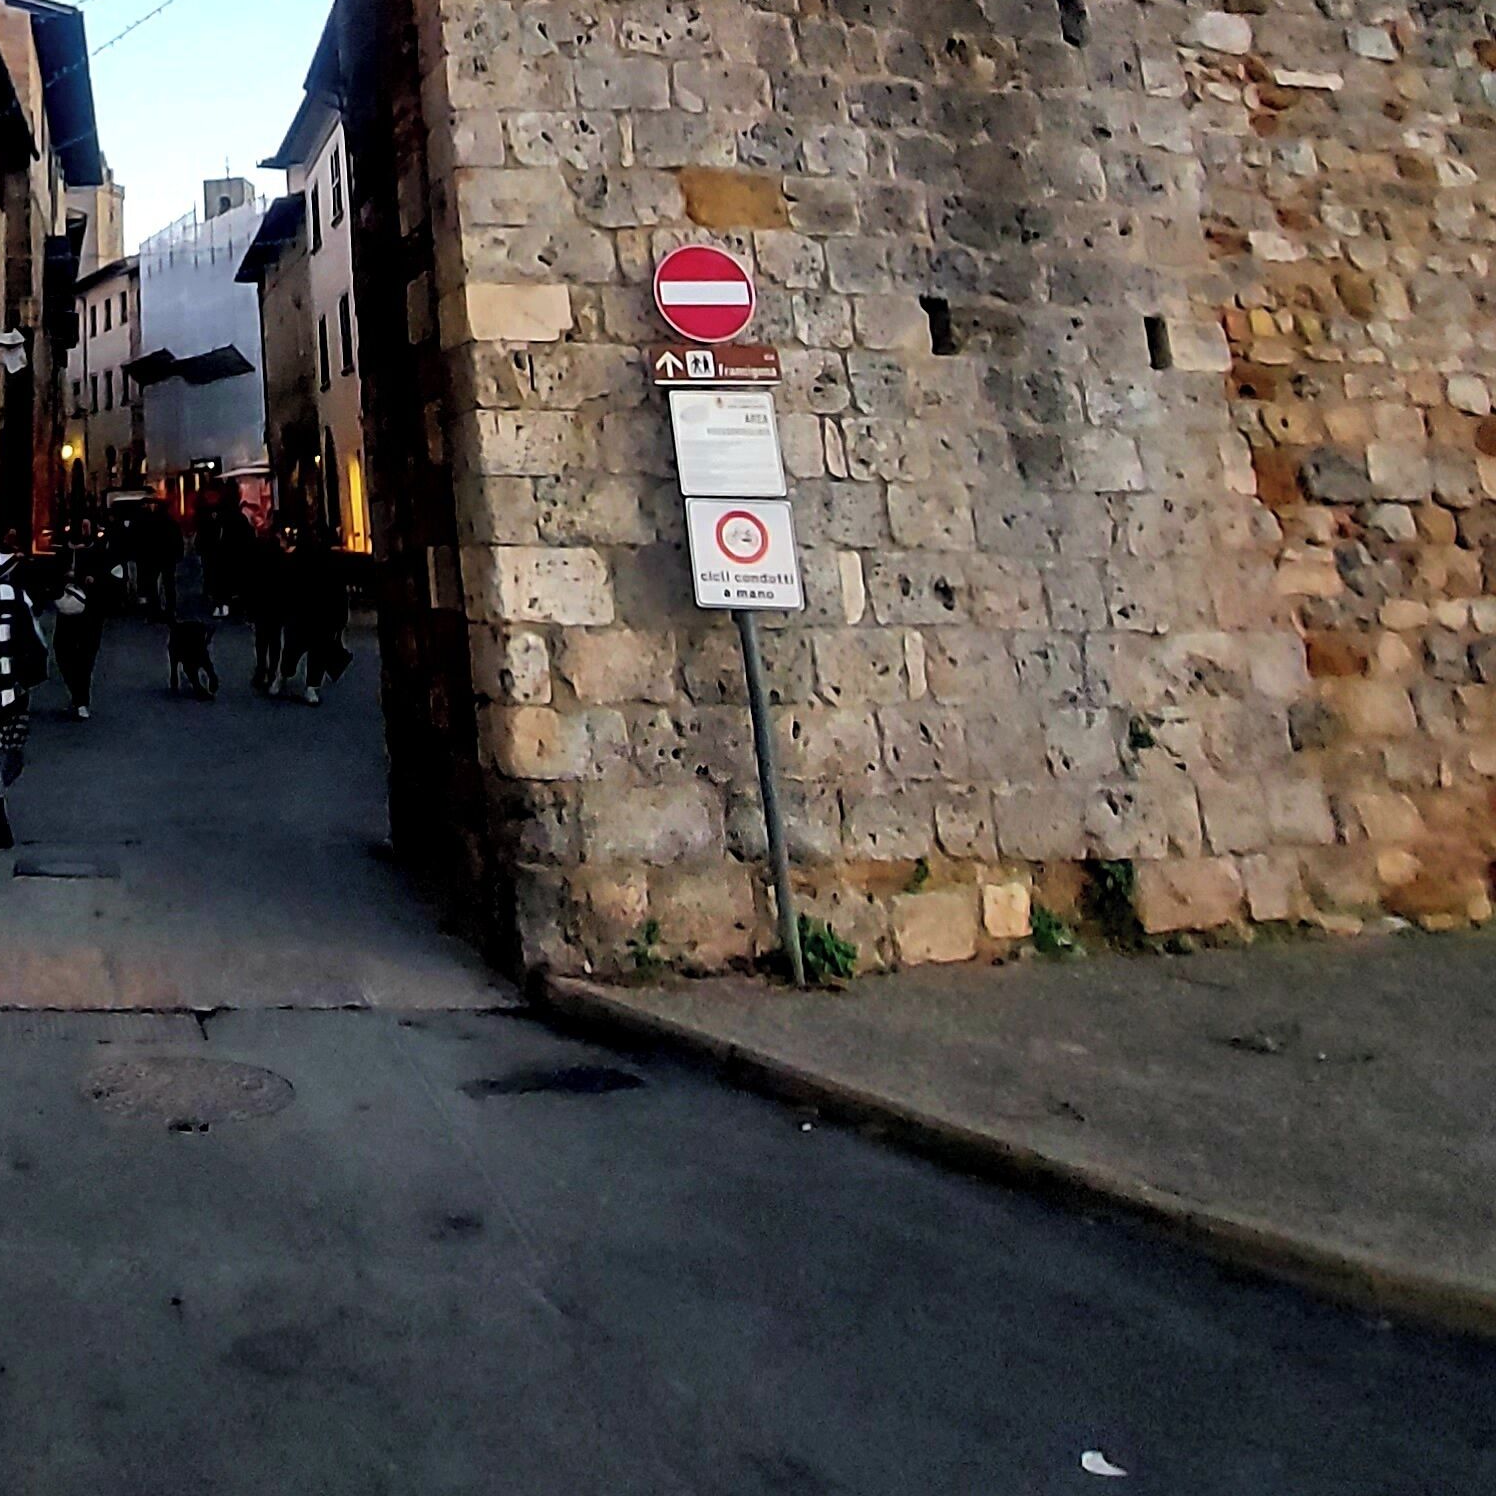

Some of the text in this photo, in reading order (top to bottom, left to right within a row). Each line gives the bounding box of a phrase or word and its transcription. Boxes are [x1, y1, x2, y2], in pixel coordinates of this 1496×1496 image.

[734, 573, 794, 585] condotti
[723, 589, 775, 599] a mano
